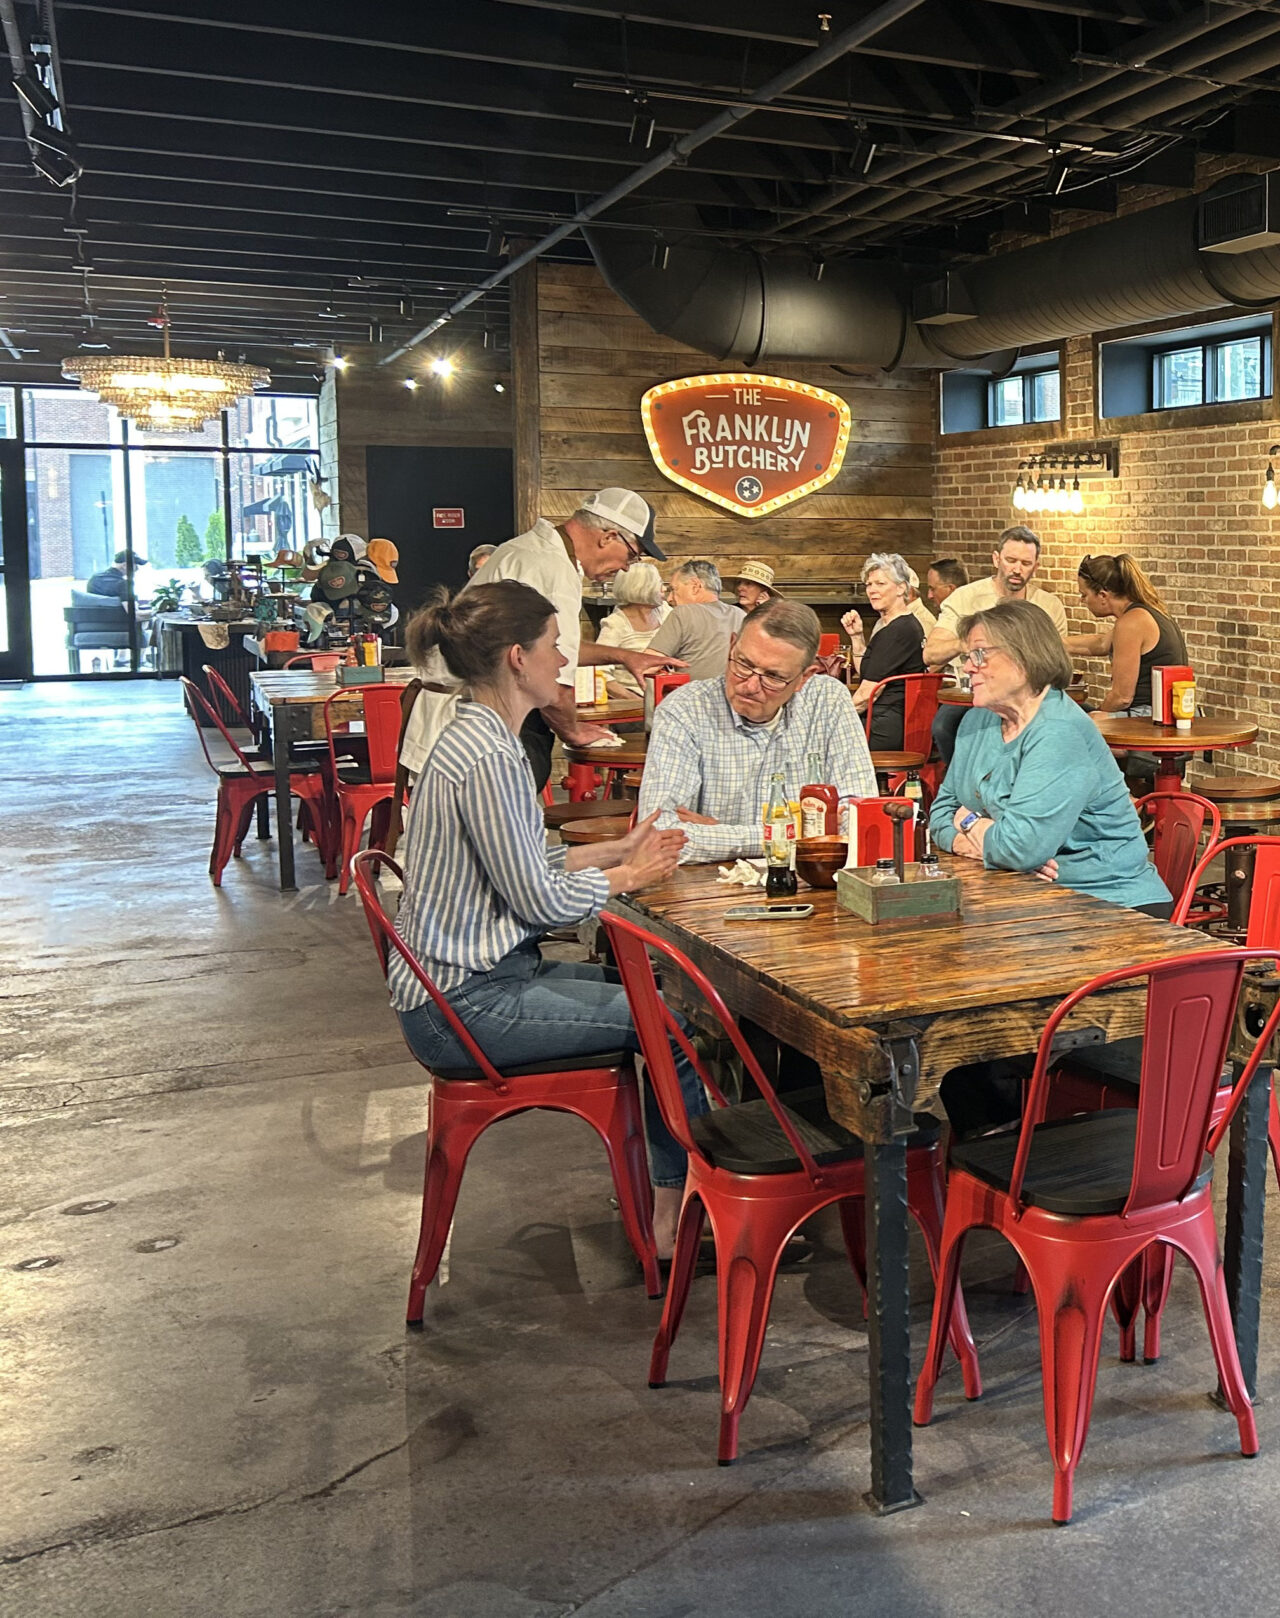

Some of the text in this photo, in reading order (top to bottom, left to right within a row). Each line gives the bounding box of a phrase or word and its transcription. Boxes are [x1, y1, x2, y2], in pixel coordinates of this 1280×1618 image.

[732, 387, 762, 406] THE
[681, 409, 811, 454] FRANKLIN
[690, 444, 806, 475] BUTCHERY
